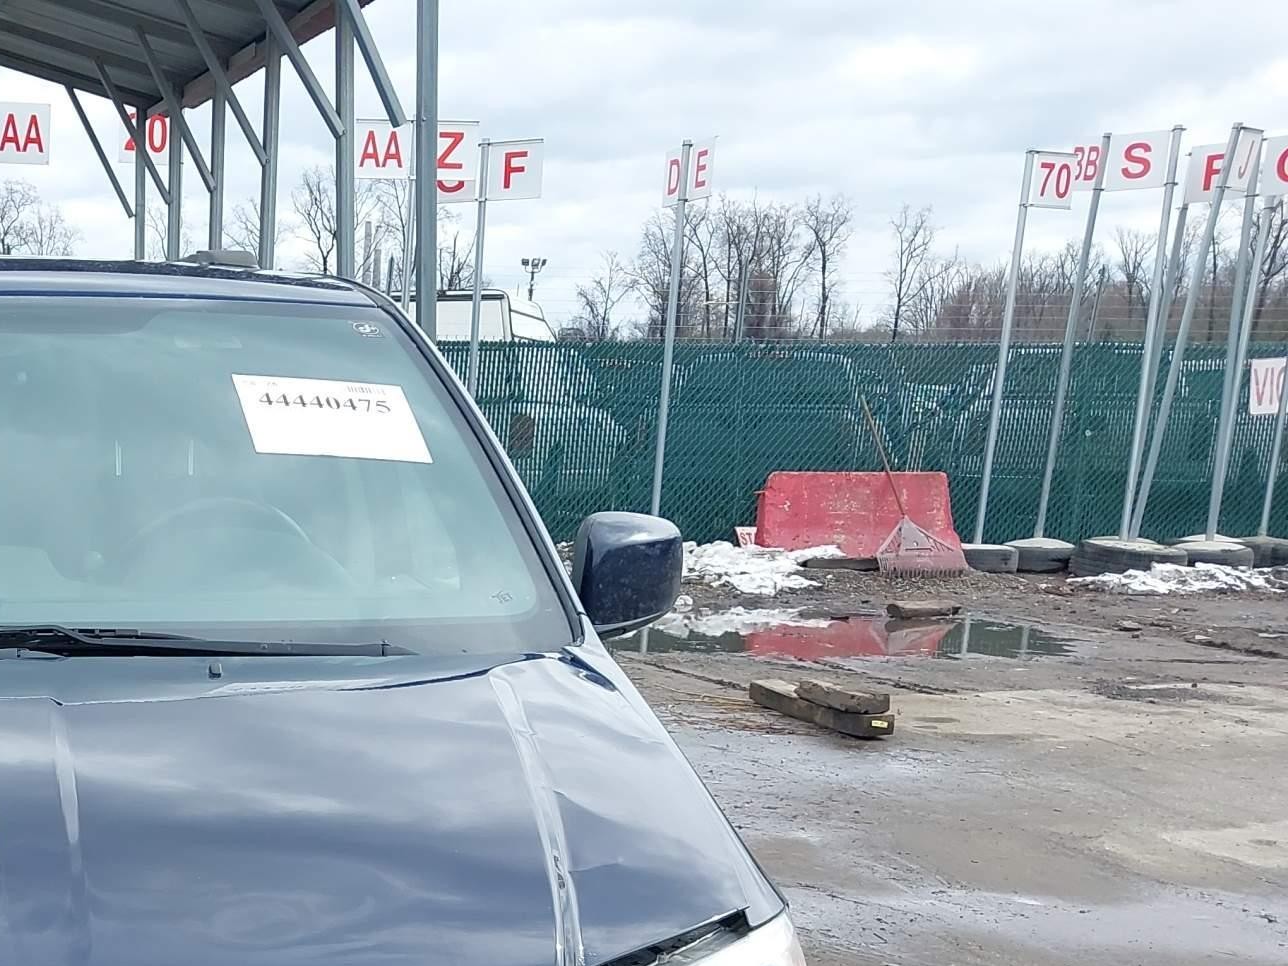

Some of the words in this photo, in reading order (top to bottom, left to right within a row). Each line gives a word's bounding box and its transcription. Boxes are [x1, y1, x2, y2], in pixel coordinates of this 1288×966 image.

[0, 113, 44, 153] AA
[359, 130, 403, 168] AA
[437, 131, 465, 170] Z
[503, 150, 529, 190] F
[667, 158, 681, 196] D
[695, 148, 709, 189] E
[1121, 141, 1153, 180] S
[1040, 162, 1072, 199] 70
[259, 392, 392, 414] 44440475
